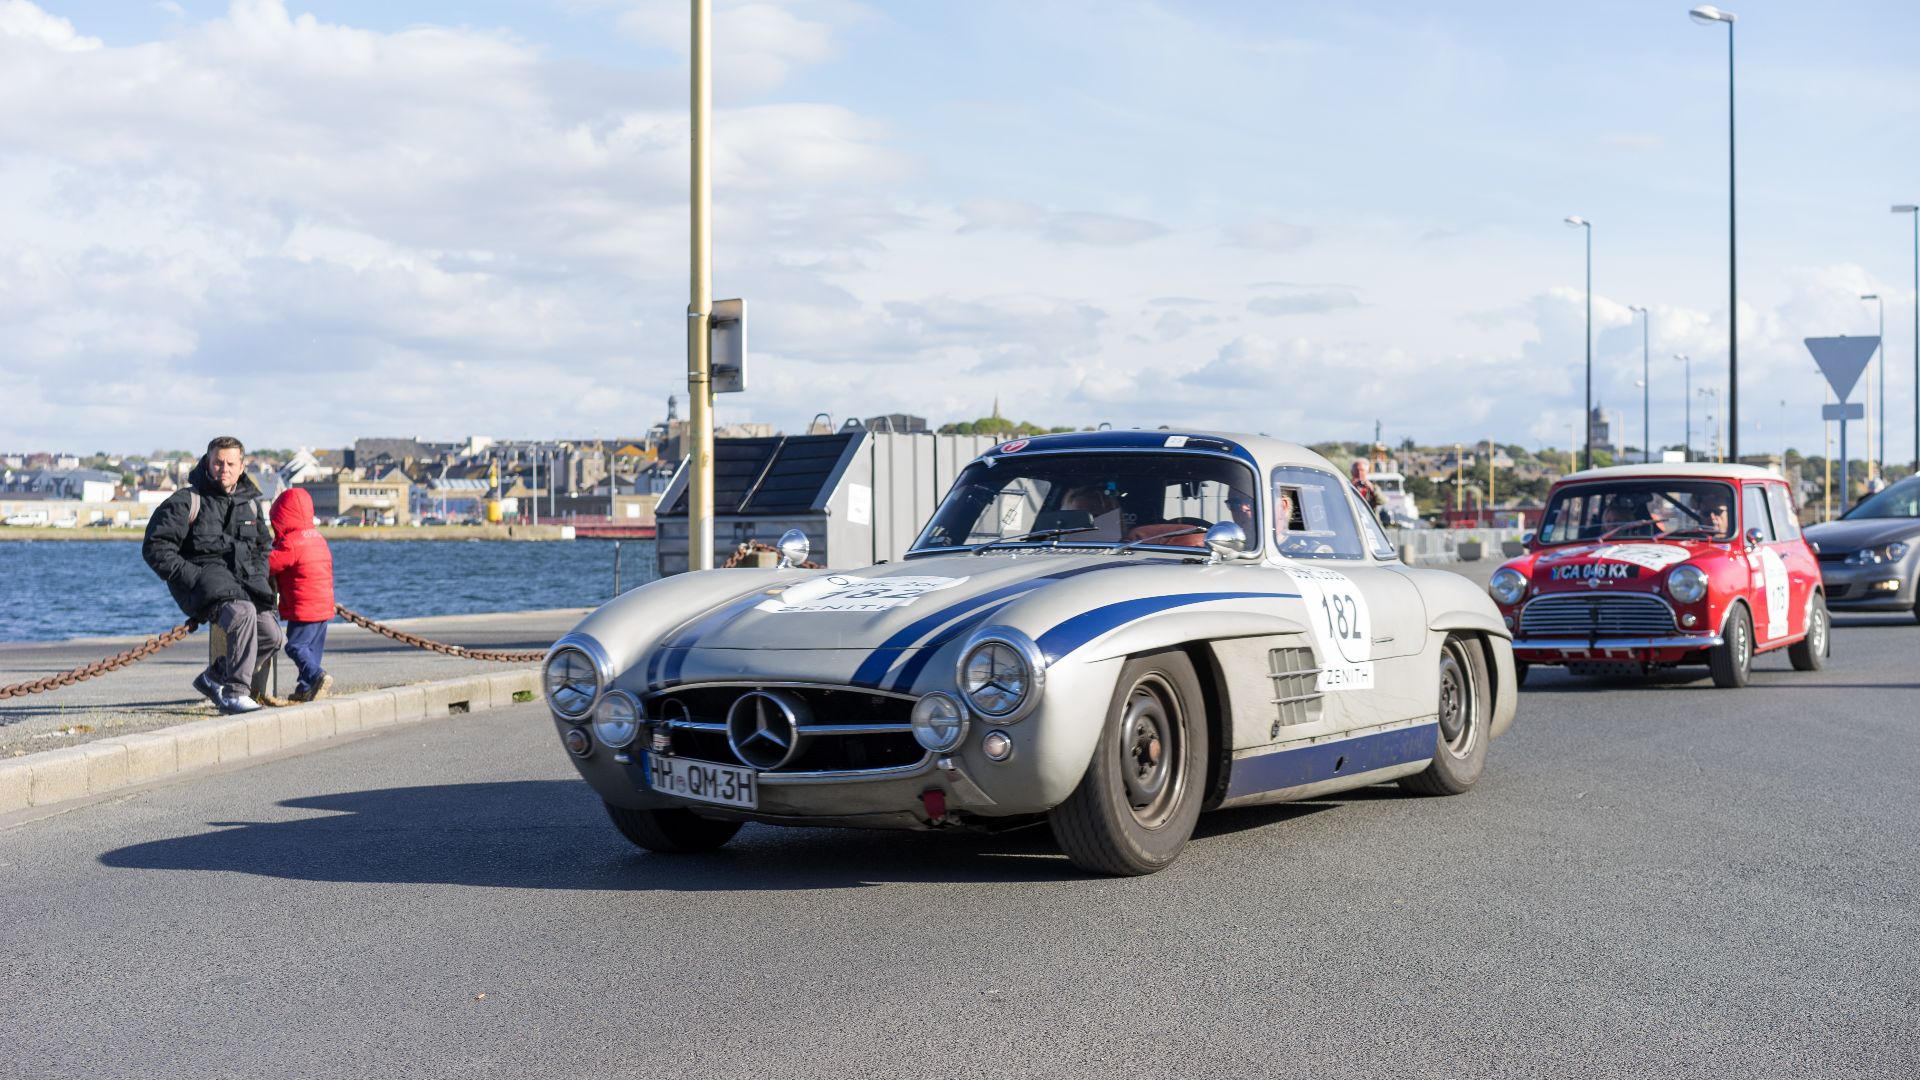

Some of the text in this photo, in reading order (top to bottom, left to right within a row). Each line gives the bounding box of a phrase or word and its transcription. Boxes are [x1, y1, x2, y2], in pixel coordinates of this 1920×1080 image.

[1608, 563, 1630, 578] KX
[815, 588, 925, 601] 182
[1322, 593, 1362, 640] 182
[1327, 668, 1370, 685] ZENITH
